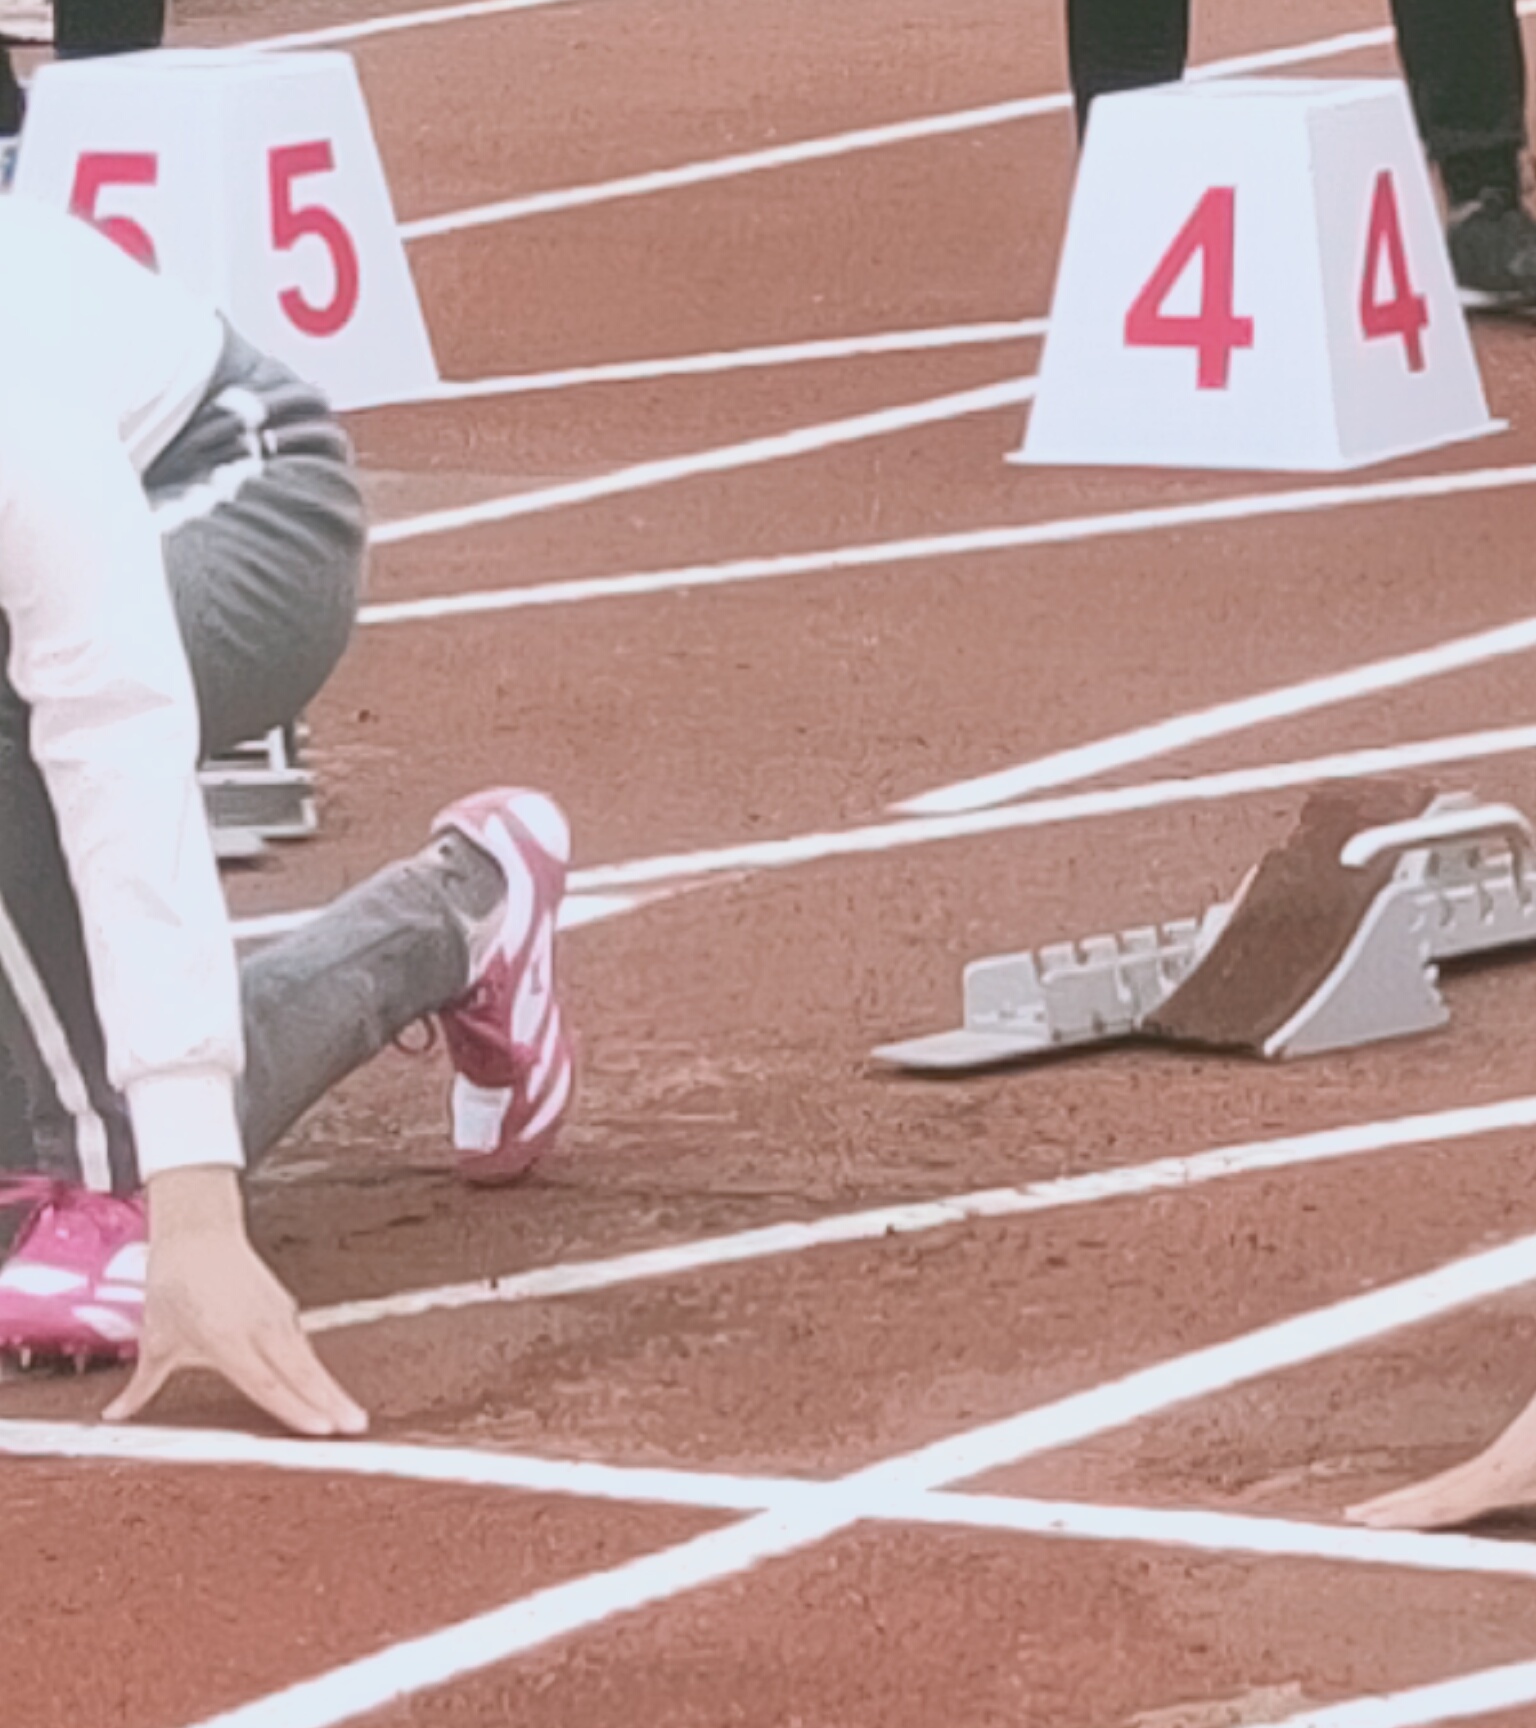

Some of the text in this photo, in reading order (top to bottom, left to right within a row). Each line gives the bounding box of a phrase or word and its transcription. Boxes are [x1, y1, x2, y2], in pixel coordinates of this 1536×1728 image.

[267, 138, 360, 338] 5
[1123, 185, 1254, 390] 4
[1359, 168, 1428, 373] 4
